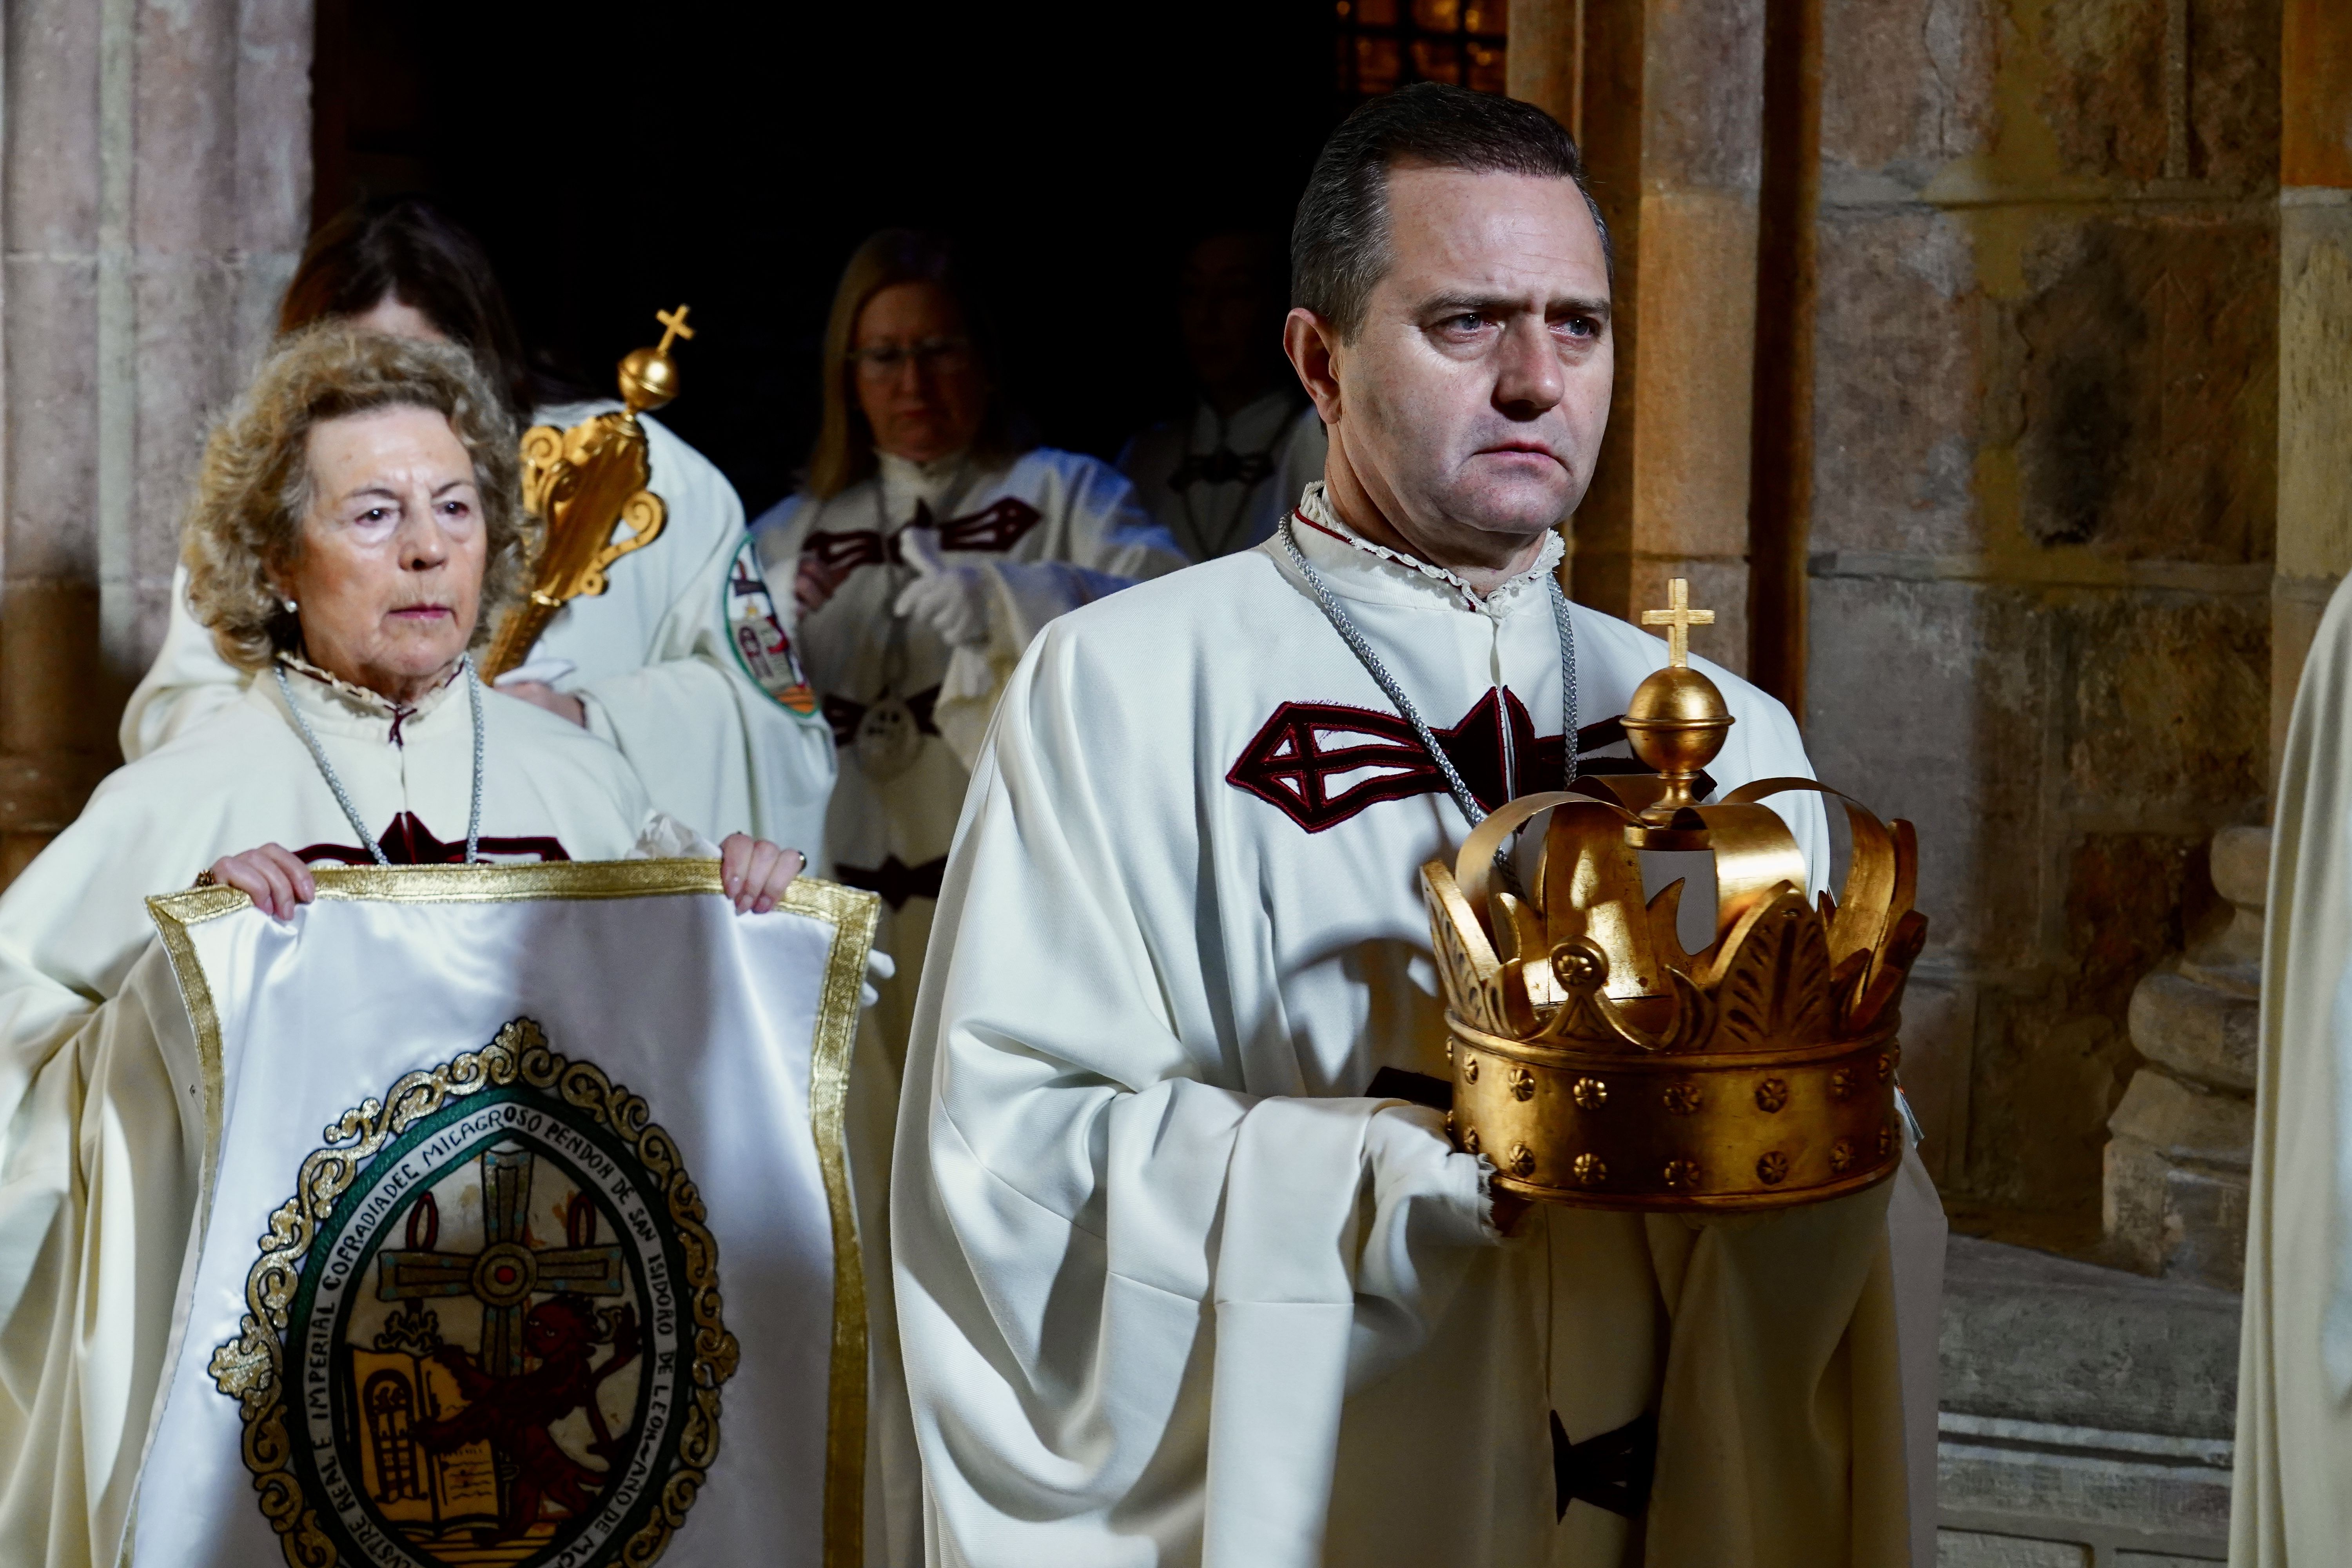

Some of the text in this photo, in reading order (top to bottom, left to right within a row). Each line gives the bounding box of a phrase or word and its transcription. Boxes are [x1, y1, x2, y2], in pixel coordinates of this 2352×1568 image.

[422, 1106, 542, 1167] MILAGROSO
[544, 1121, 615, 1180] PENDON
[610, 1178, 636, 1205] DE
[628, 1208, 657, 1241] SAN
[648, 1254, 673, 1334] ISIDORO
[309, 1302, 335, 1419] IMPERIAL
[657, 1352, 673, 1375] DE
[645, 1385, 668, 1441] LEON
[313, 1436, 332, 1449] E
[321, 1456, 355, 1512] REAL
[595, 1508, 620, 1534] DE
[558, 1534, 594, 1568] MC
